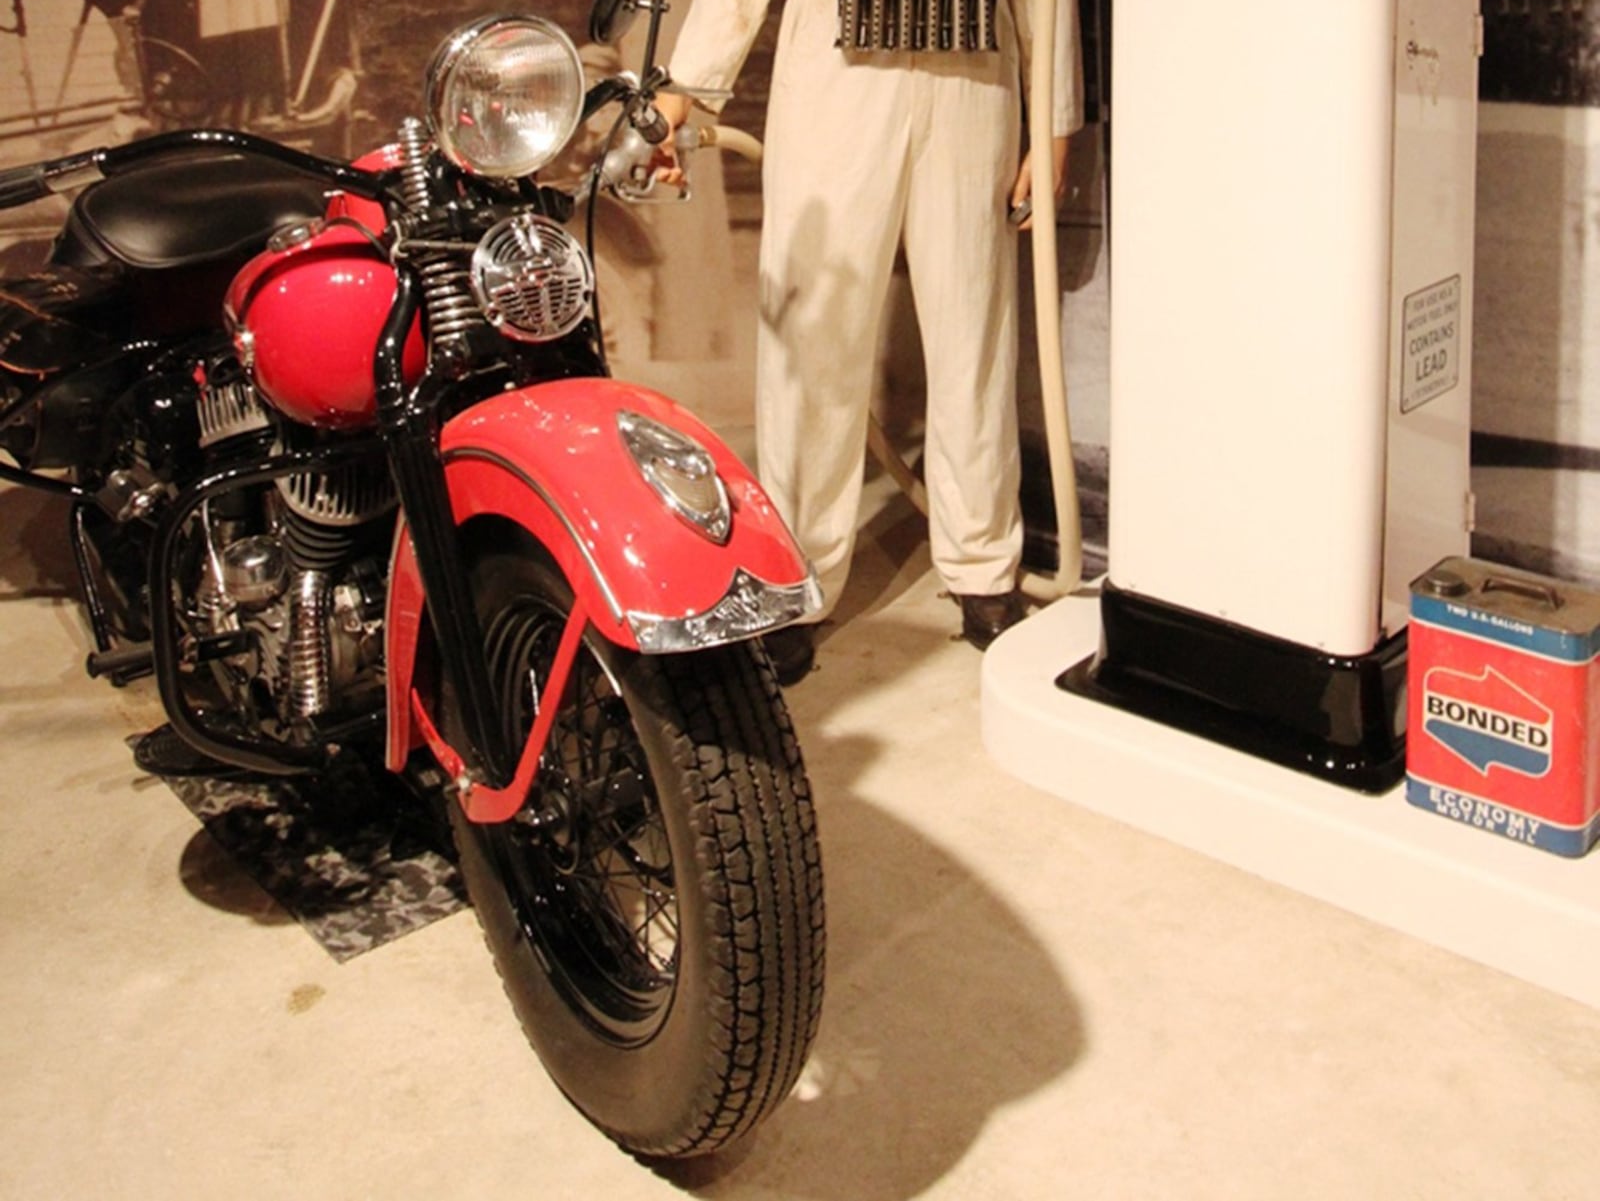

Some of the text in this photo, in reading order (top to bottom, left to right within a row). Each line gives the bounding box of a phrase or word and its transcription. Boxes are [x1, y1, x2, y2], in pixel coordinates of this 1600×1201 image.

[1409, 321, 1455, 356] CONTAINS
[1415, 348, 1448, 382] LEAD
[1446, 603, 1468, 617] TWO
[1427, 695, 1548, 747] BONDED
[1429, 786, 1541, 835] ECONOMY
[1436, 801, 1536, 845] MOTOR OIL
